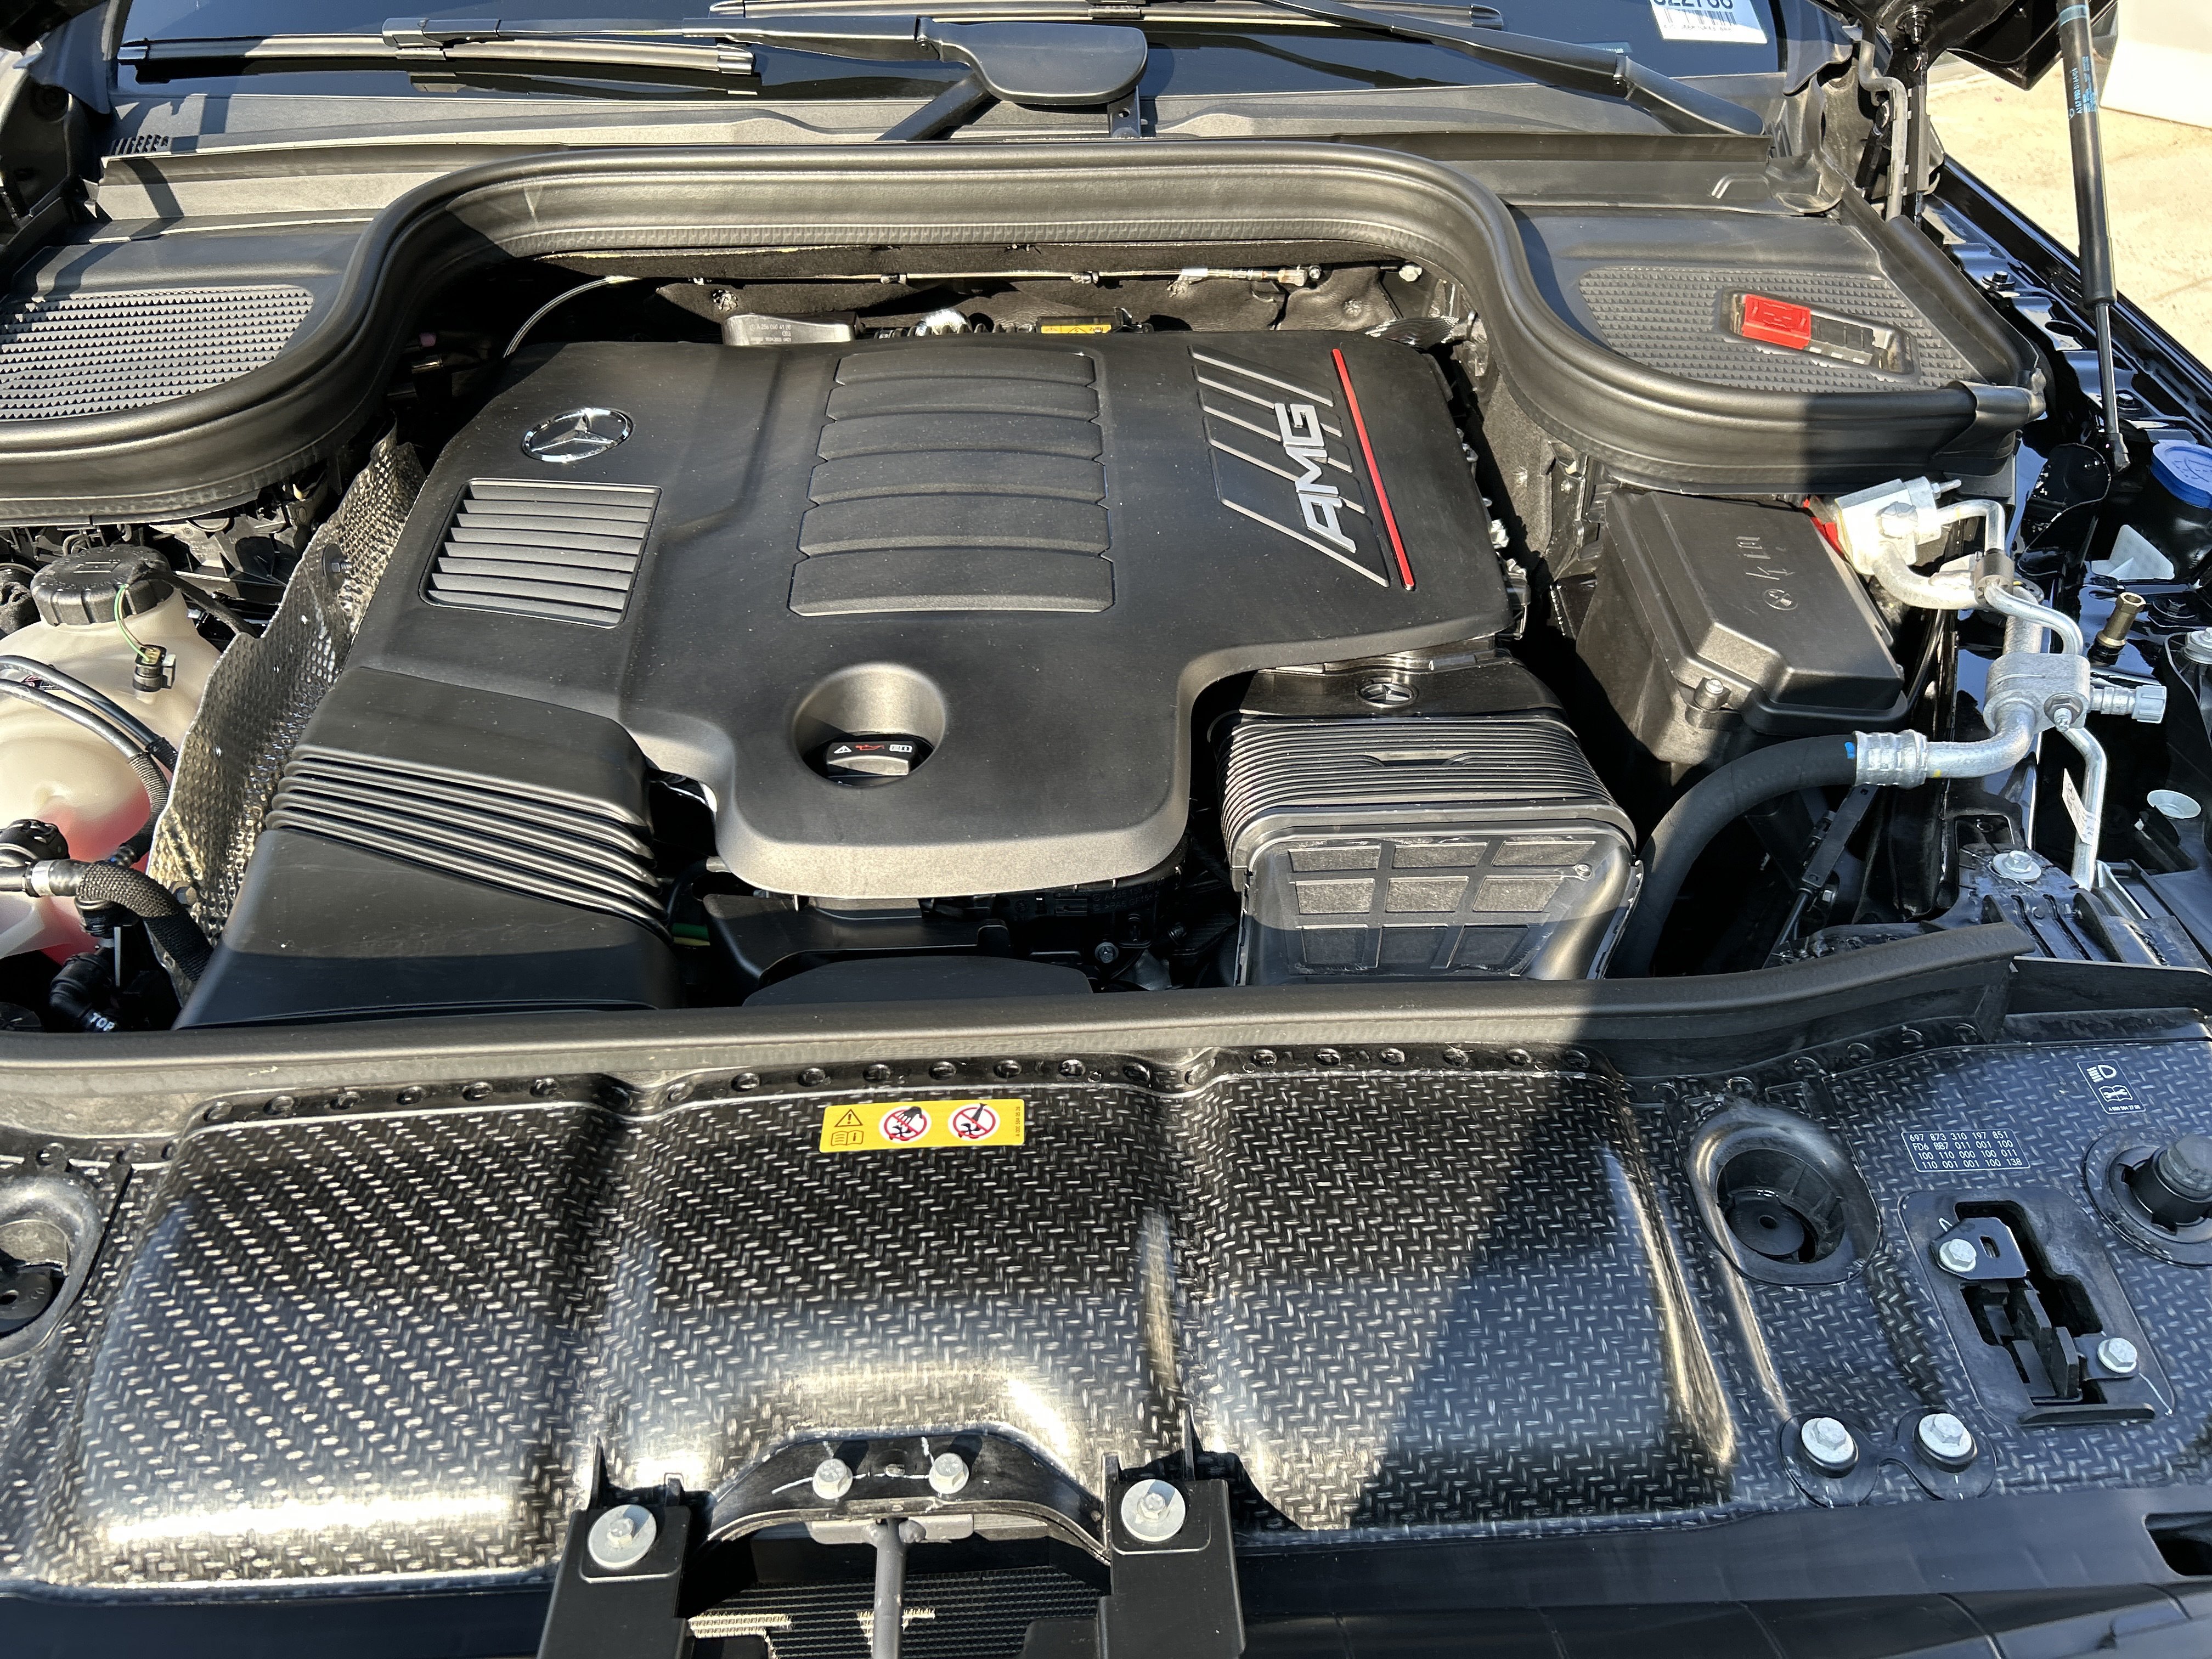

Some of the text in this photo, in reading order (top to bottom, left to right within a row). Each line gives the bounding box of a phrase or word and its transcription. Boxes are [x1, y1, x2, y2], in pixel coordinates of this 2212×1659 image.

[1274, 403, 1356, 553] AMG
[90, 1012, 115, 1031] TOP
[1910, 1133, 1924, 1142] 697
[1930, 1133, 1946, 1141] 873
